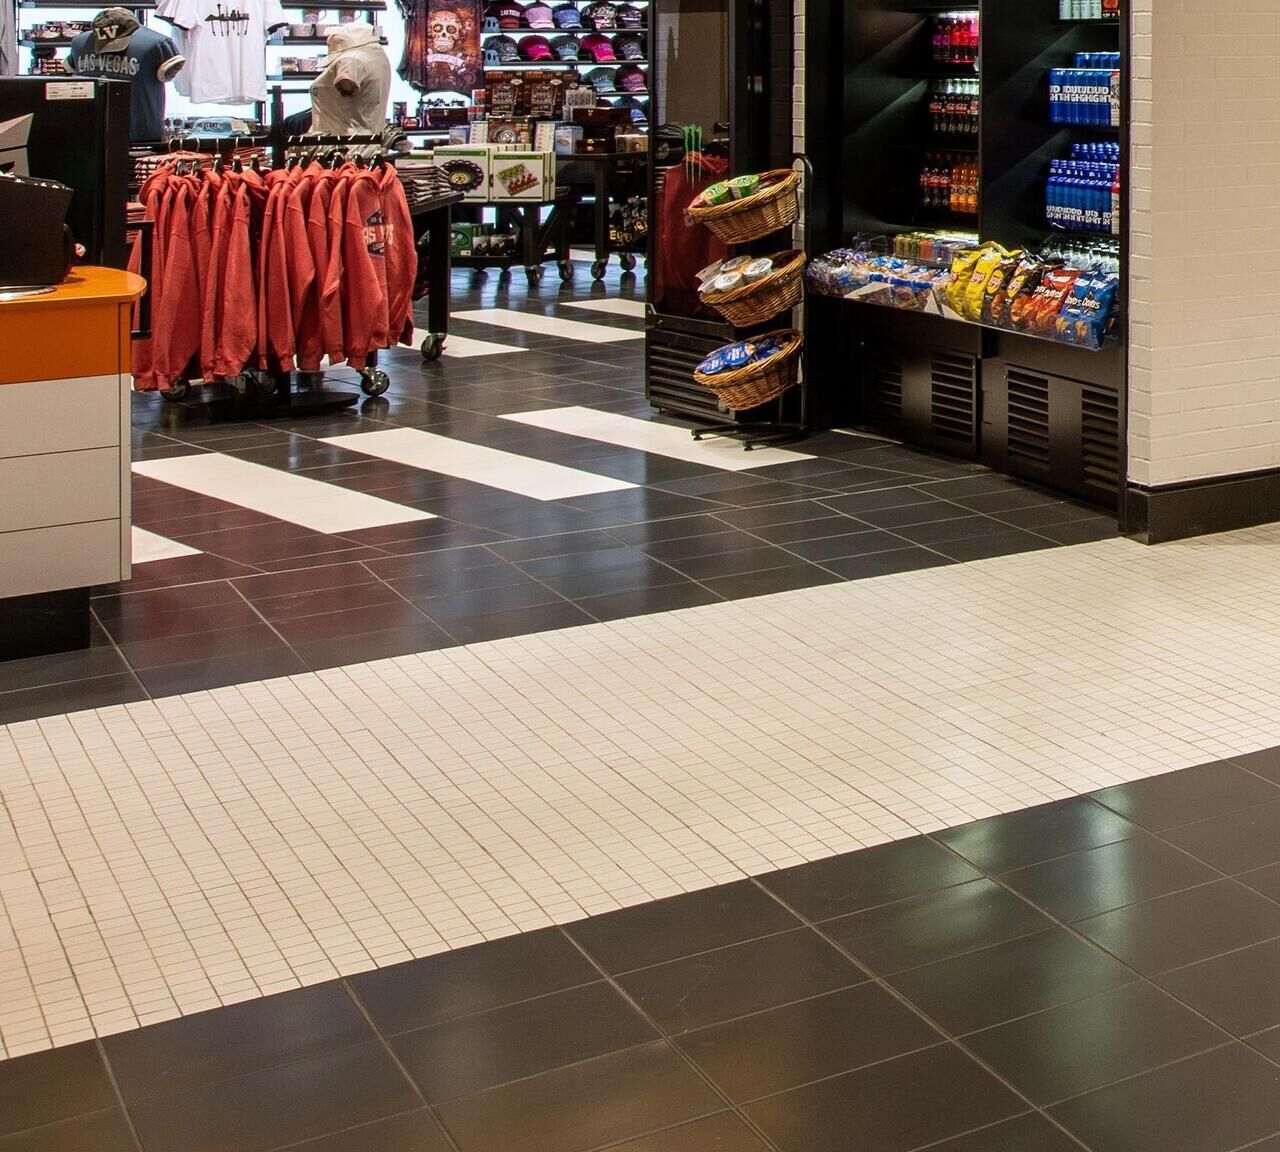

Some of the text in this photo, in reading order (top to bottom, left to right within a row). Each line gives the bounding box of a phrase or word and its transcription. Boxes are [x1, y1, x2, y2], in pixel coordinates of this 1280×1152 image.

[96, 25, 118, 40] LV
[78, 54, 138, 75] LAS VEGAS
